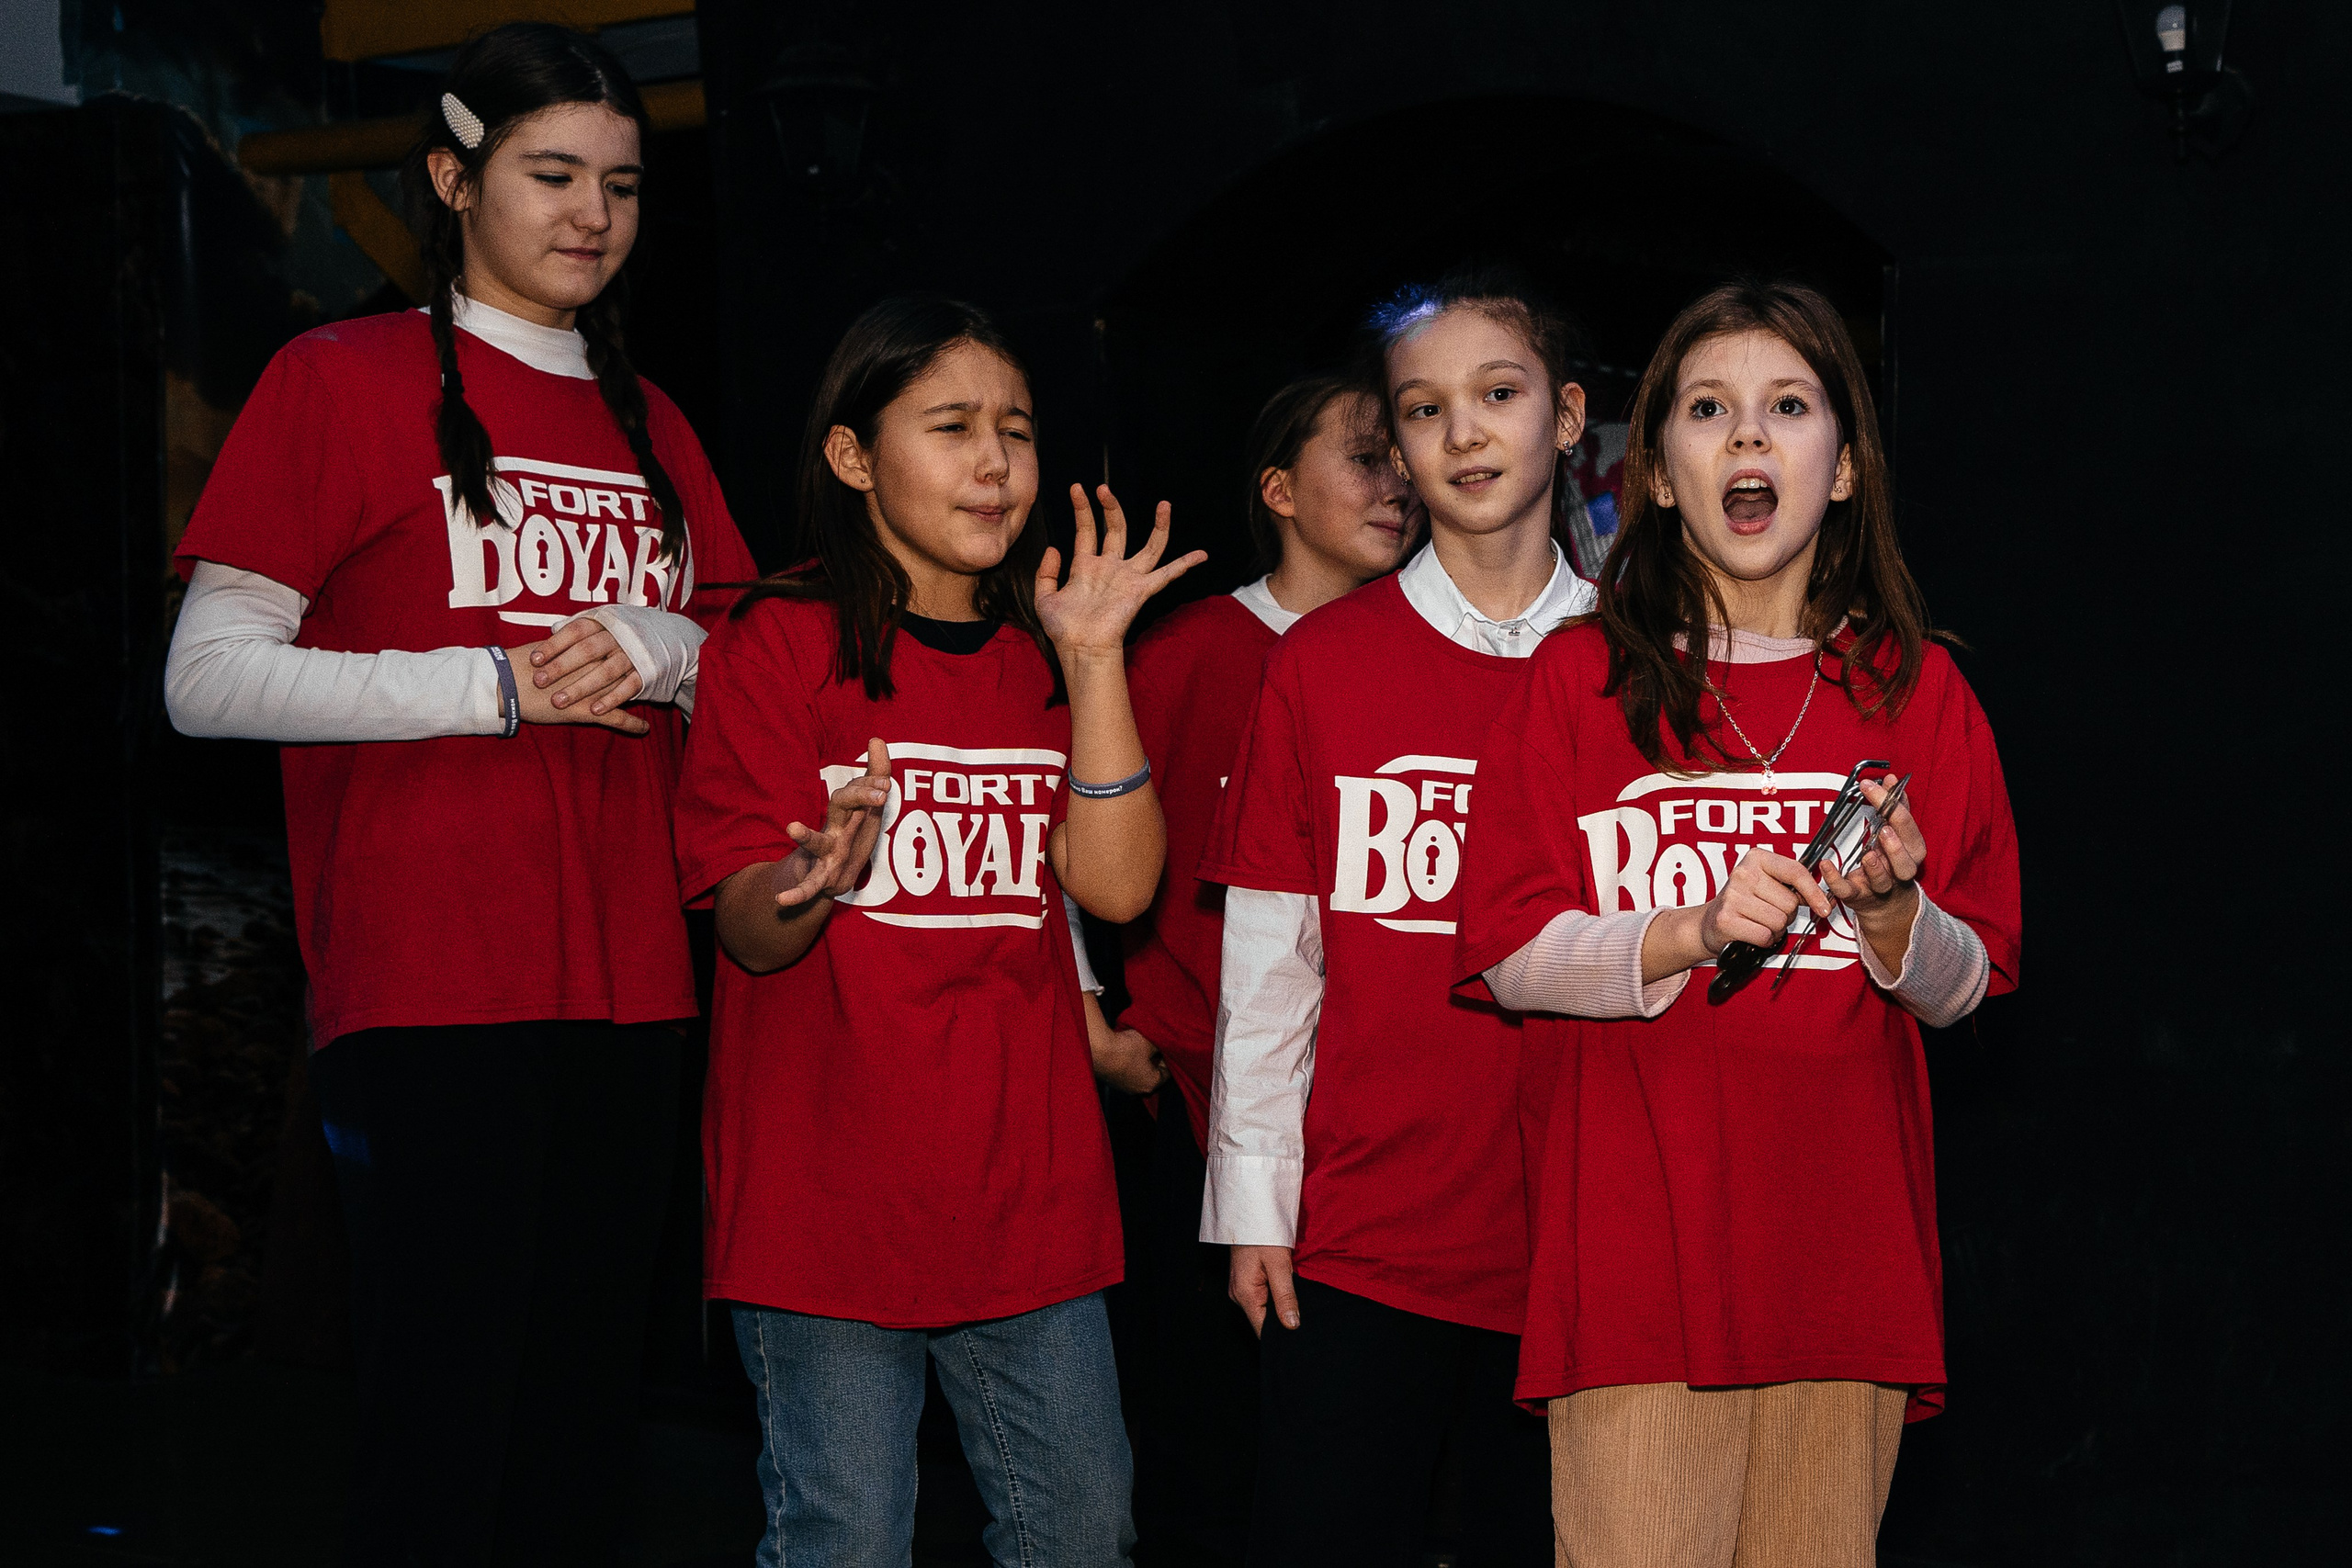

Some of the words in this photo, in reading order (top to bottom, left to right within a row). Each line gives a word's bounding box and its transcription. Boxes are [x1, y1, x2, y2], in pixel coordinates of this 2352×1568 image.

[518, 478, 650, 521] FORT
[904, 769, 1043, 806] FORT
[1659, 799, 1820, 834] FORT
[1329, 775, 1466, 914] BO
